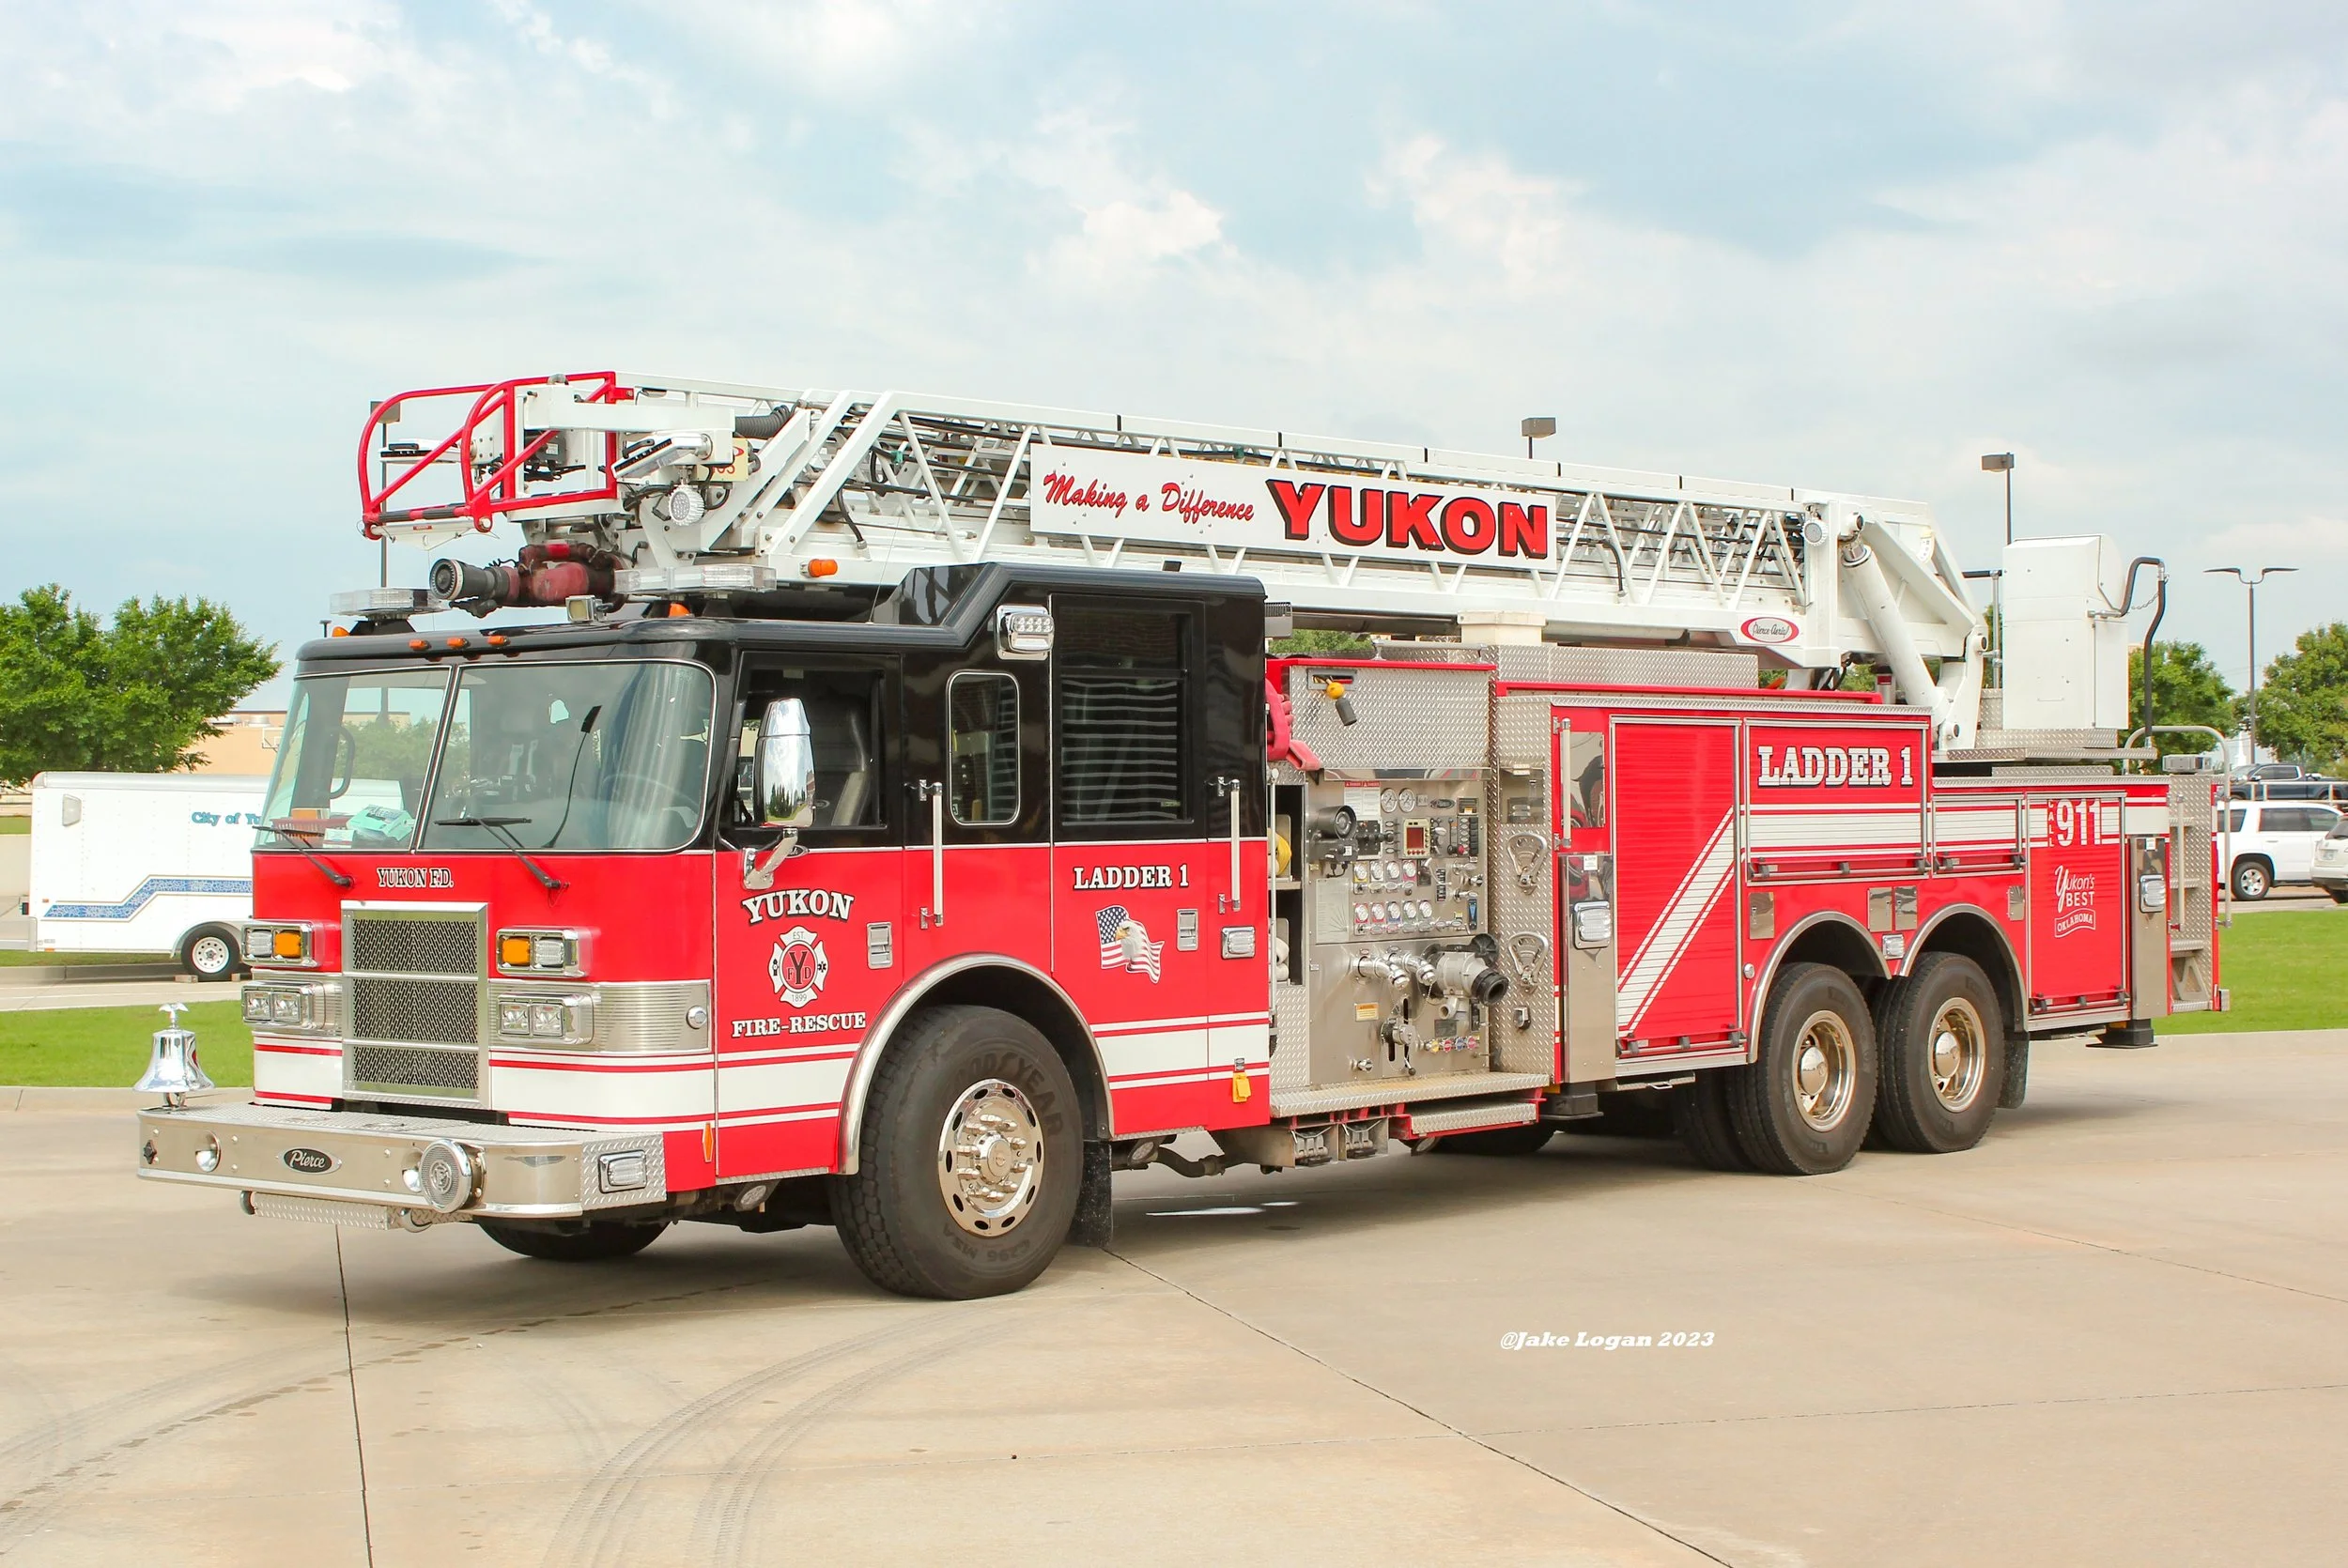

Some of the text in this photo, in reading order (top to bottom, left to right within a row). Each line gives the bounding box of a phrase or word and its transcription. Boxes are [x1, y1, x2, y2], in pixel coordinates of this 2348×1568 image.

[1043, 470, 1256, 524] Making a Difference
[1266, 478, 1549, 560] YUKON
[1753, 622, 1770, 636] Pierce
[1756, 745, 1914, 788] LADDER 1
[192, 811, 221, 827] City
[224, 812, 241, 825] of
[2056, 798, 2101, 847] 911
[376, 867, 425, 888] YUKON
[1073, 864, 1190, 890] LADDER 1
[2054, 865, 2095, 914] Yukon's
[2066, 891, 2095, 907] BEST
[742, 889, 854, 925] YUKON
[2056, 914, 2093, 933] OKLAHOMA
[793, 931, 806, 940] EST.
[791, 993, 808, 1003] 1899
[732, 1012, 866, 1038] FIRE-RESCUE
[289, 1149, 326, 1168] Pierce
